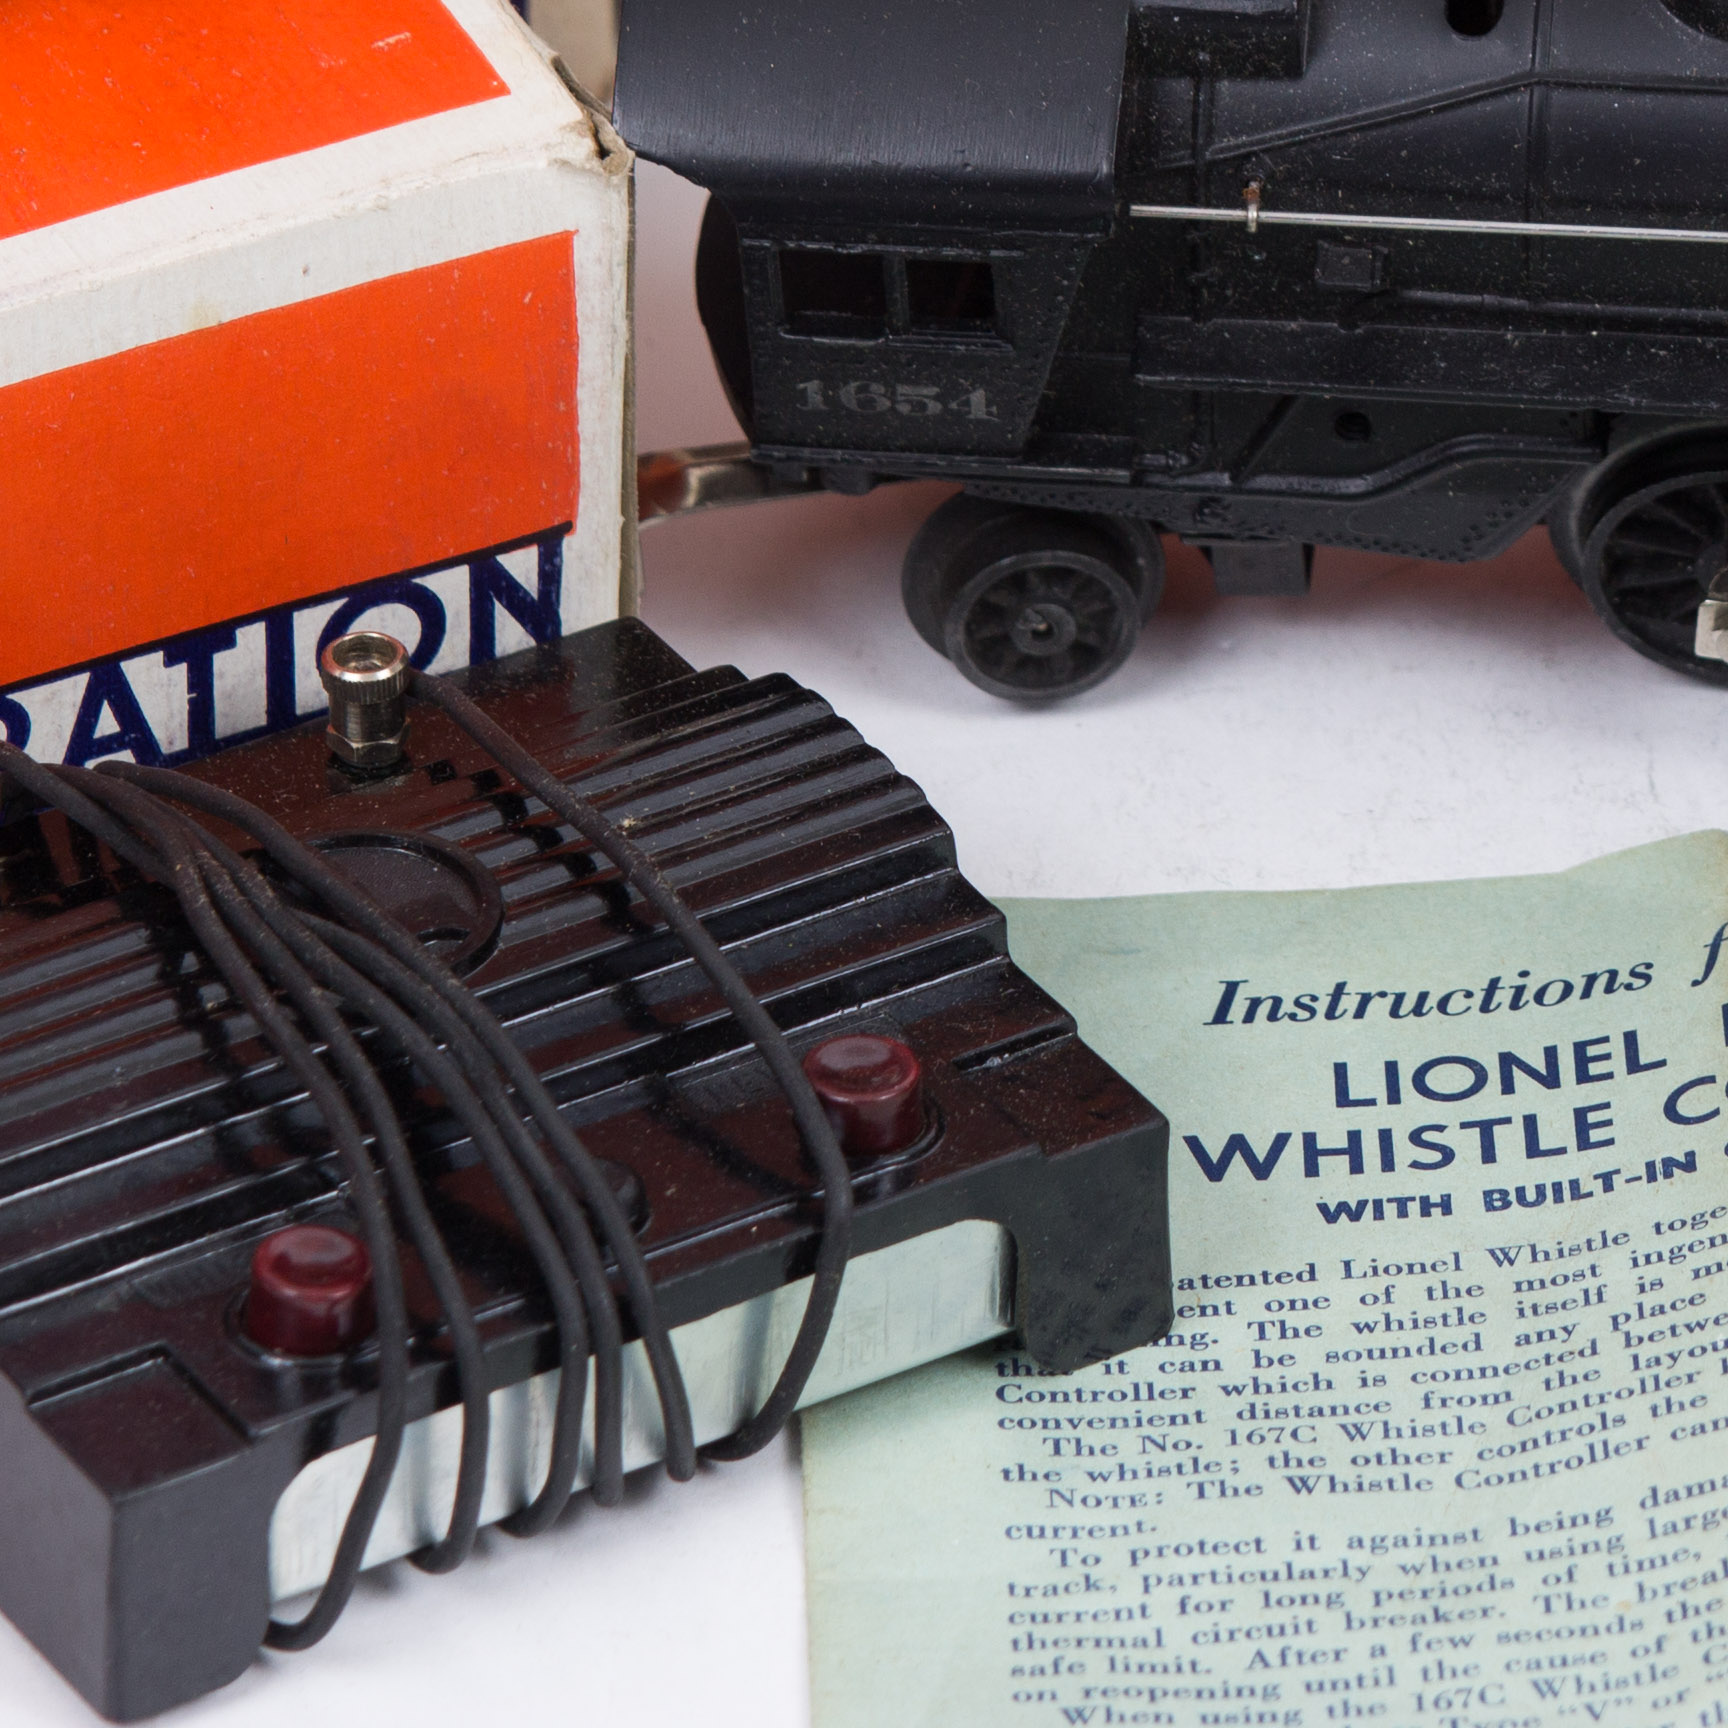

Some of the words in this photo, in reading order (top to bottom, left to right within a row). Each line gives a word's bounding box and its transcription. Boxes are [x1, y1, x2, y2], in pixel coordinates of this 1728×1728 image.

[796, 377, 999, 423] 1654
[1203, 960, 1656, 1026] Instructions
[1331, 1028, 1667, 1109] LIONEL
[1182, 1100, 1616, 1183] WHISTLE
[1315, 1192, 1453, 1224] WITH
[1482, 1149, 1698, 1214] BUILT-IN
[1175, 1300, 1239, 1320] ent
[1263, 1296, 1333, 1314] one
[1358, 1284, 1398, 1307] of
[1425, 1279, 1487, 1303] the
[1512, 1263, 1601, 1295] most
[1176, 1262, 1320, 1292] atented
[1339, 1251, 1465, 1281] Lionel
[1484, 1229, 1633, 1269] Whistle
[1102, 1356, 1132, 1377] it
[1157, 1358, 1225, 1375] can
[1250, 1348, 1299, 1370] be
[1324, 1332, 1485, 1365] sounded
[1513, 1323, 1579, 1348] any
[1608, 1292, 1709, 1334] place
[1245, 1319, 1325, 1343] The
[1349, 1306, 1489, 1336] whistle
[1514, 1283, 1610, 1320] itself
[1636, 1275, 1666, 1296] is
[994, 1381, 1199, 1405] Controller
[1217, 1371, 1336, 1398] which
[1357, 1370, 1389, 1390] is
[1409, 1338, 1601, 1385] connected
[996, 1408, 1208, 1431] convenient
[1235, 1401, 1393, 1422] distance
[1422, 1390, 1514, 1411] from
[1543, 1369, 1602, 1393] the
[1000, 1463, 1063, 1483] the
[1085, 1456, 1242, 1484] whistle;
[1266, 1450, 1328, 1470] the
[1349, 1446, 1454, 1467] other
[1476, 1411, 1629, 1462] controls
[1649, 1395, 1709, 1420] the
[1041, 1437, 1120, 1458] The
[1140, 1434, 1205, 1455] No.
[1226, 1424, 1318, 1447] 167C
[1337, 1415, 1488, 1443] Whistle
[1505, 1371, 1701, 1428] Controller
[1185, 1479, 1265, 1501] The
[1284, 1472, 1435, 1496] Whistle
[1453, 1434, 1651, 1489] Controller
[1004, 1518, 1158, 1543] current.
[1049, 1547, 1102, 1569] To
[1128, 1536, 1267, 1568] protect
[1291, 1530, 1322, 1552] it
[1346, 1525, 1484, 1555] against
